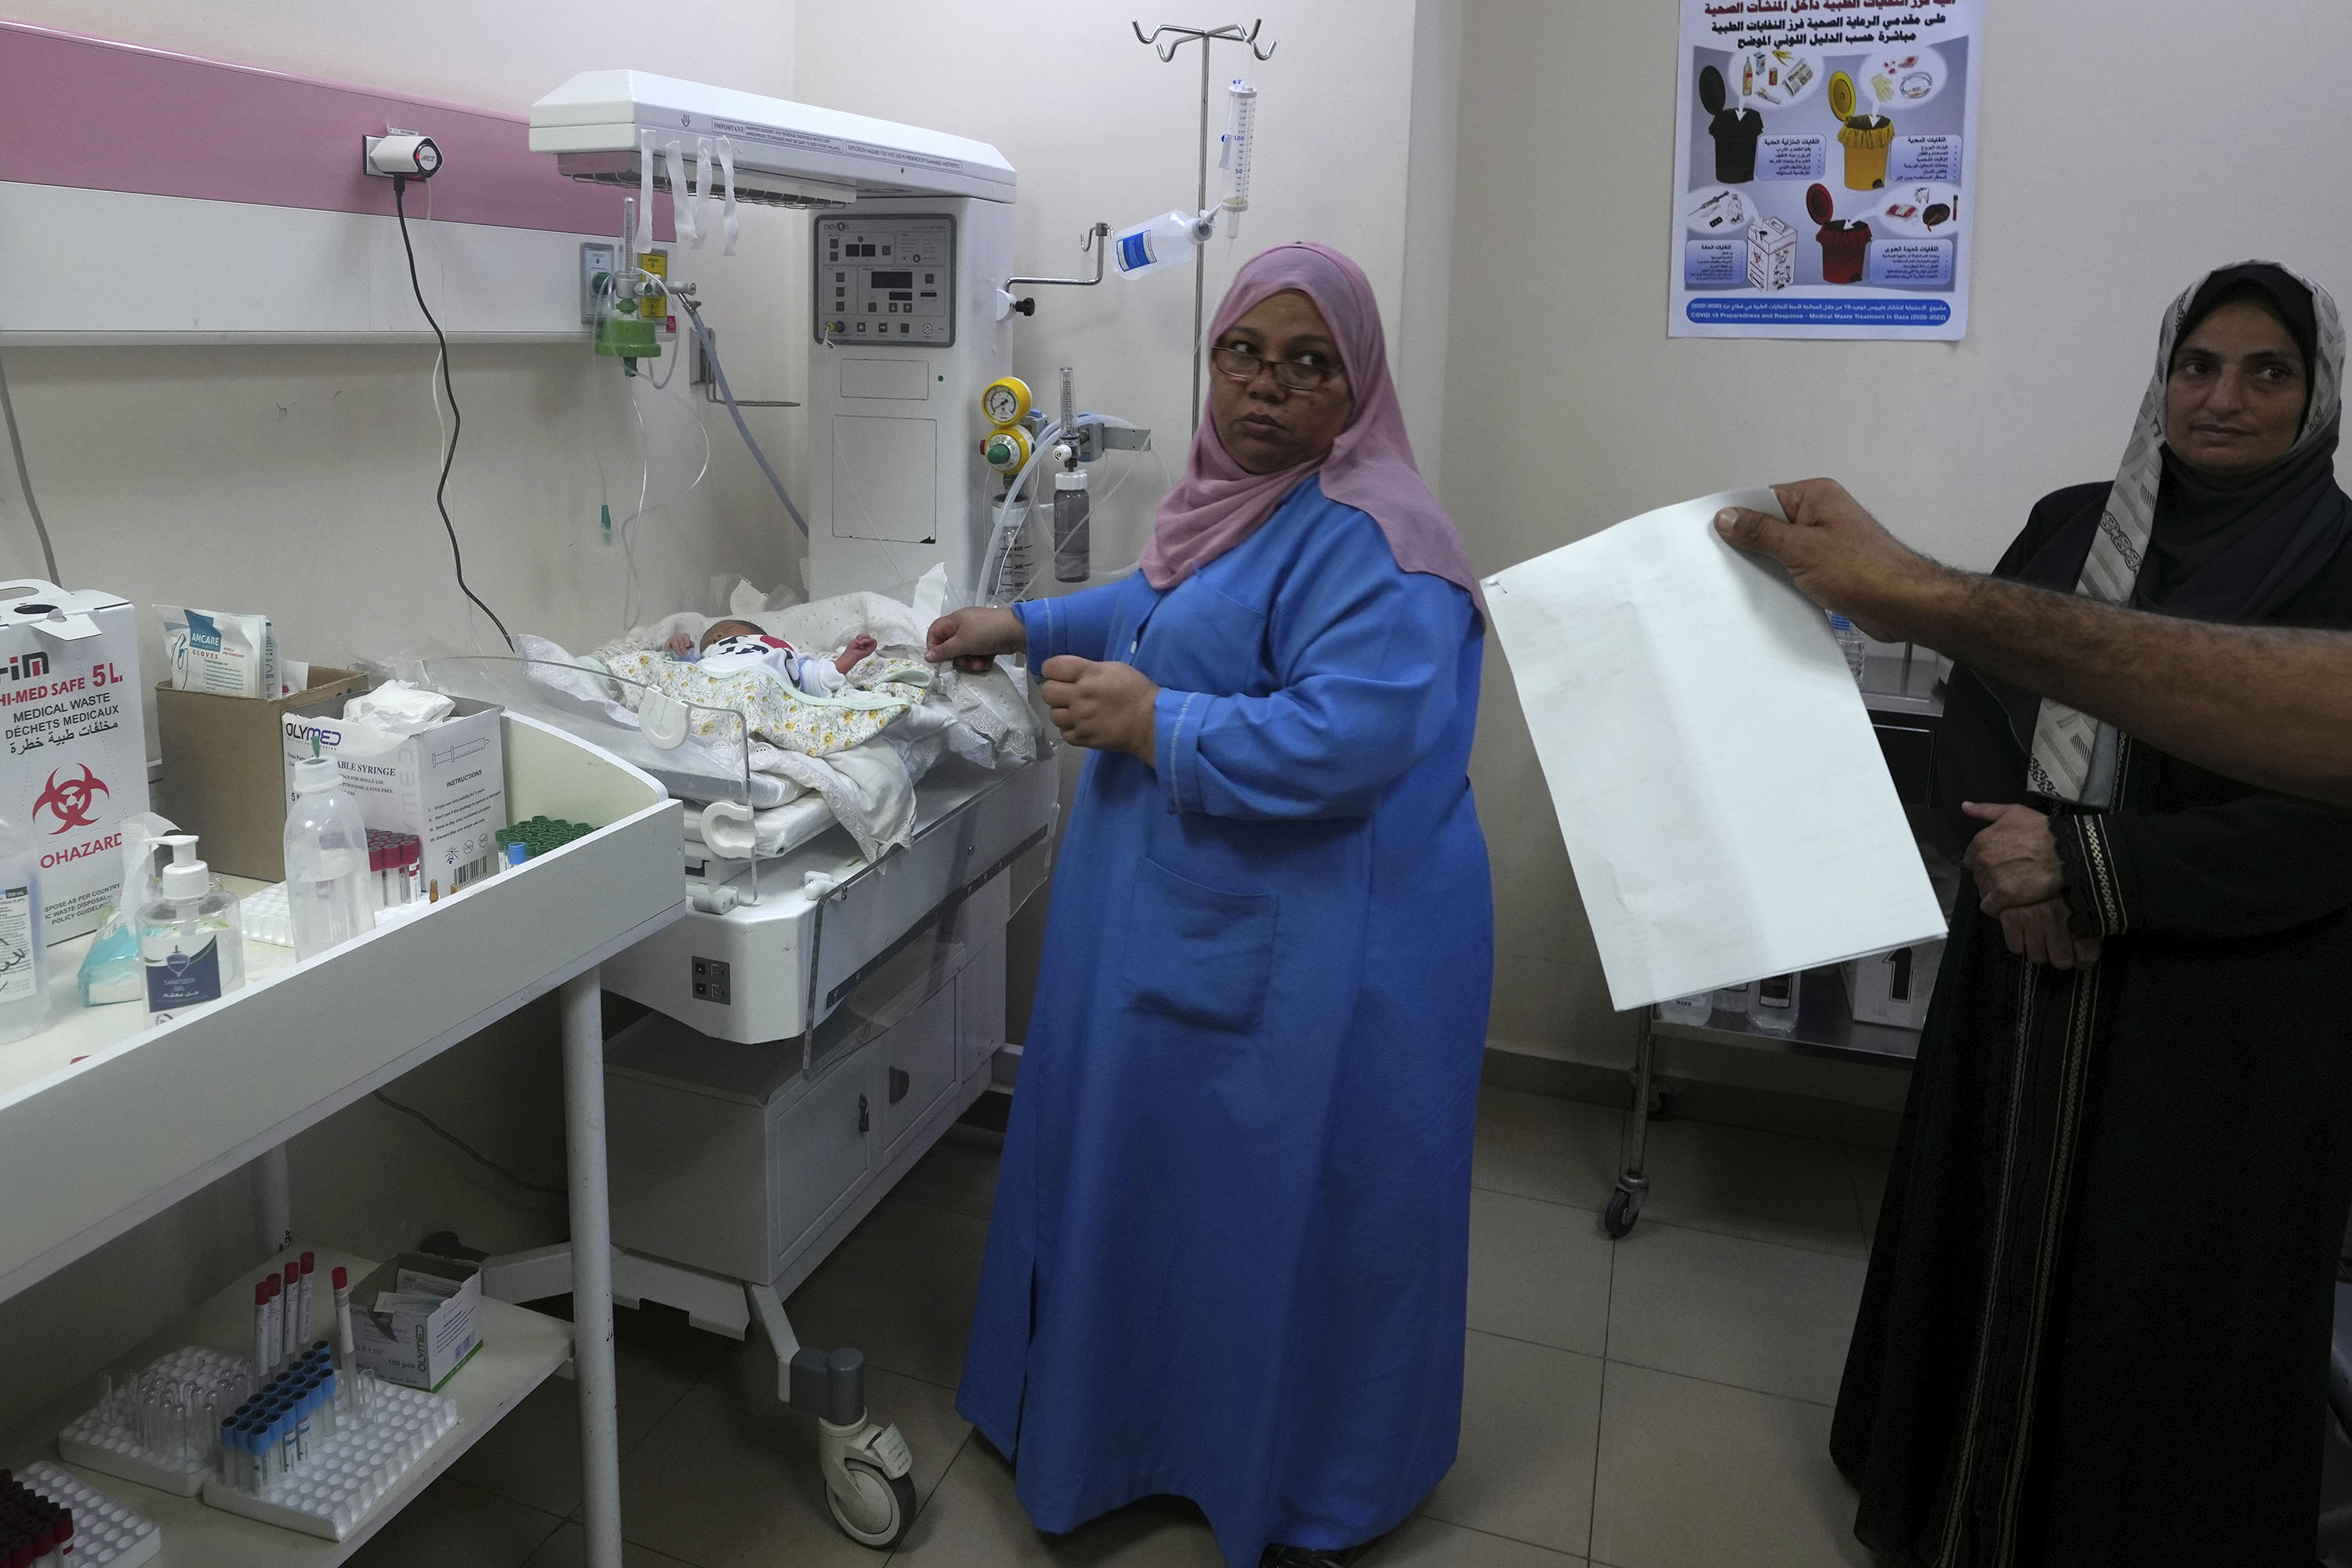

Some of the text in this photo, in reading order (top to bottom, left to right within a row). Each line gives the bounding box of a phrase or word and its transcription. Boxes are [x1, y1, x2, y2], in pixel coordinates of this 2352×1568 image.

[1704, 2, 1744, 17] الصحية
[1711, 13, 1946, 34] على مقدمي الرعاية الصحية فرز النفايات الطبية
[1737, 30, 1916, 49] مباشرة حسب الدليل اللوني الموضح
[714, 122, 745, 133] IMPORTANT:
[191, 633, 220, 647] AMCARE
[192, 649, 219, 659] GLOVES
[51, 677, 86, 696] SAFE
[13, 692, 111, 723] MEDICAL WASTE
[5, 705, 119, 739] DÉCHETS MEDICAUX
[10, 720, 118, 755] مخلفات طبية خطرة
[358, 764, 396, 776] SYRINGE
[446, 769, 482, 787] INSTRUCTIONS
[78, 893, 91, 902] PER
[92, 883, 121, 897] COUNTRY
[53, 895, 107, 917] WASTE DISPOSAL
[52, 913, 75, 924] POLICY
[163, 977, 195, 985] SANITIZER
[415, 1324, 426, 1372] OLYMED
[388, 1359, 401, 1368] 100
